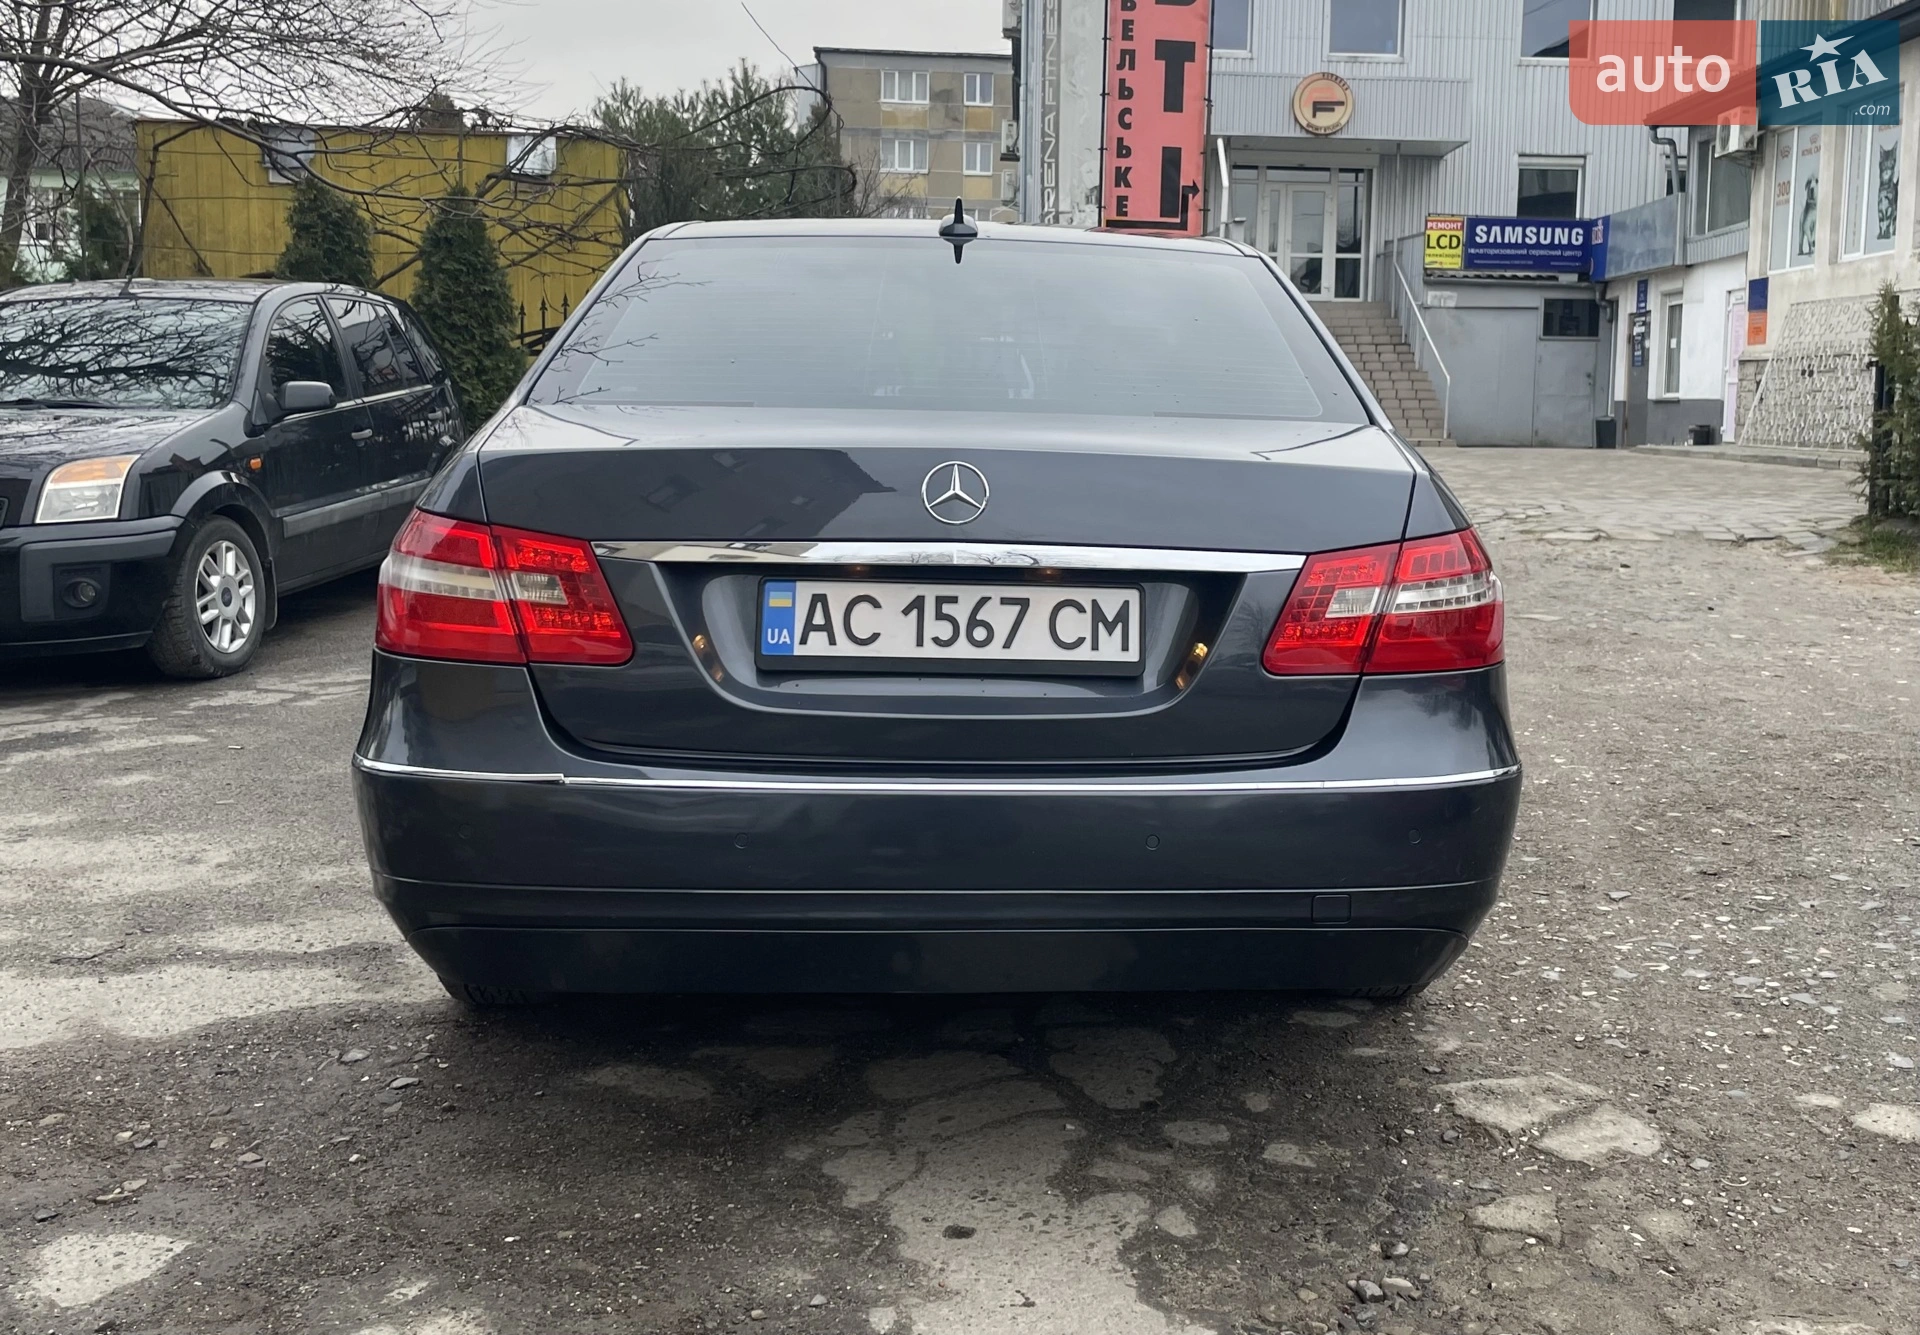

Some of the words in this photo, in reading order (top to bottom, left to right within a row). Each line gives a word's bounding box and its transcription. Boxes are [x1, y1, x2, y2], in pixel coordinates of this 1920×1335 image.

[1154, 0, 1196, 218] ТІ
[1427, 221, 1463, 230] РЕМОНТ
[1474, 224, 1584, 246] SAMSUNG
[1426, 233, 1461, 250] LCD
[799, 593, 882, 646] AC
[900, 594, 1031, 649] 1567
[1049, 598, 1130, 652] CM
[767, 628, 791, 645] UA
